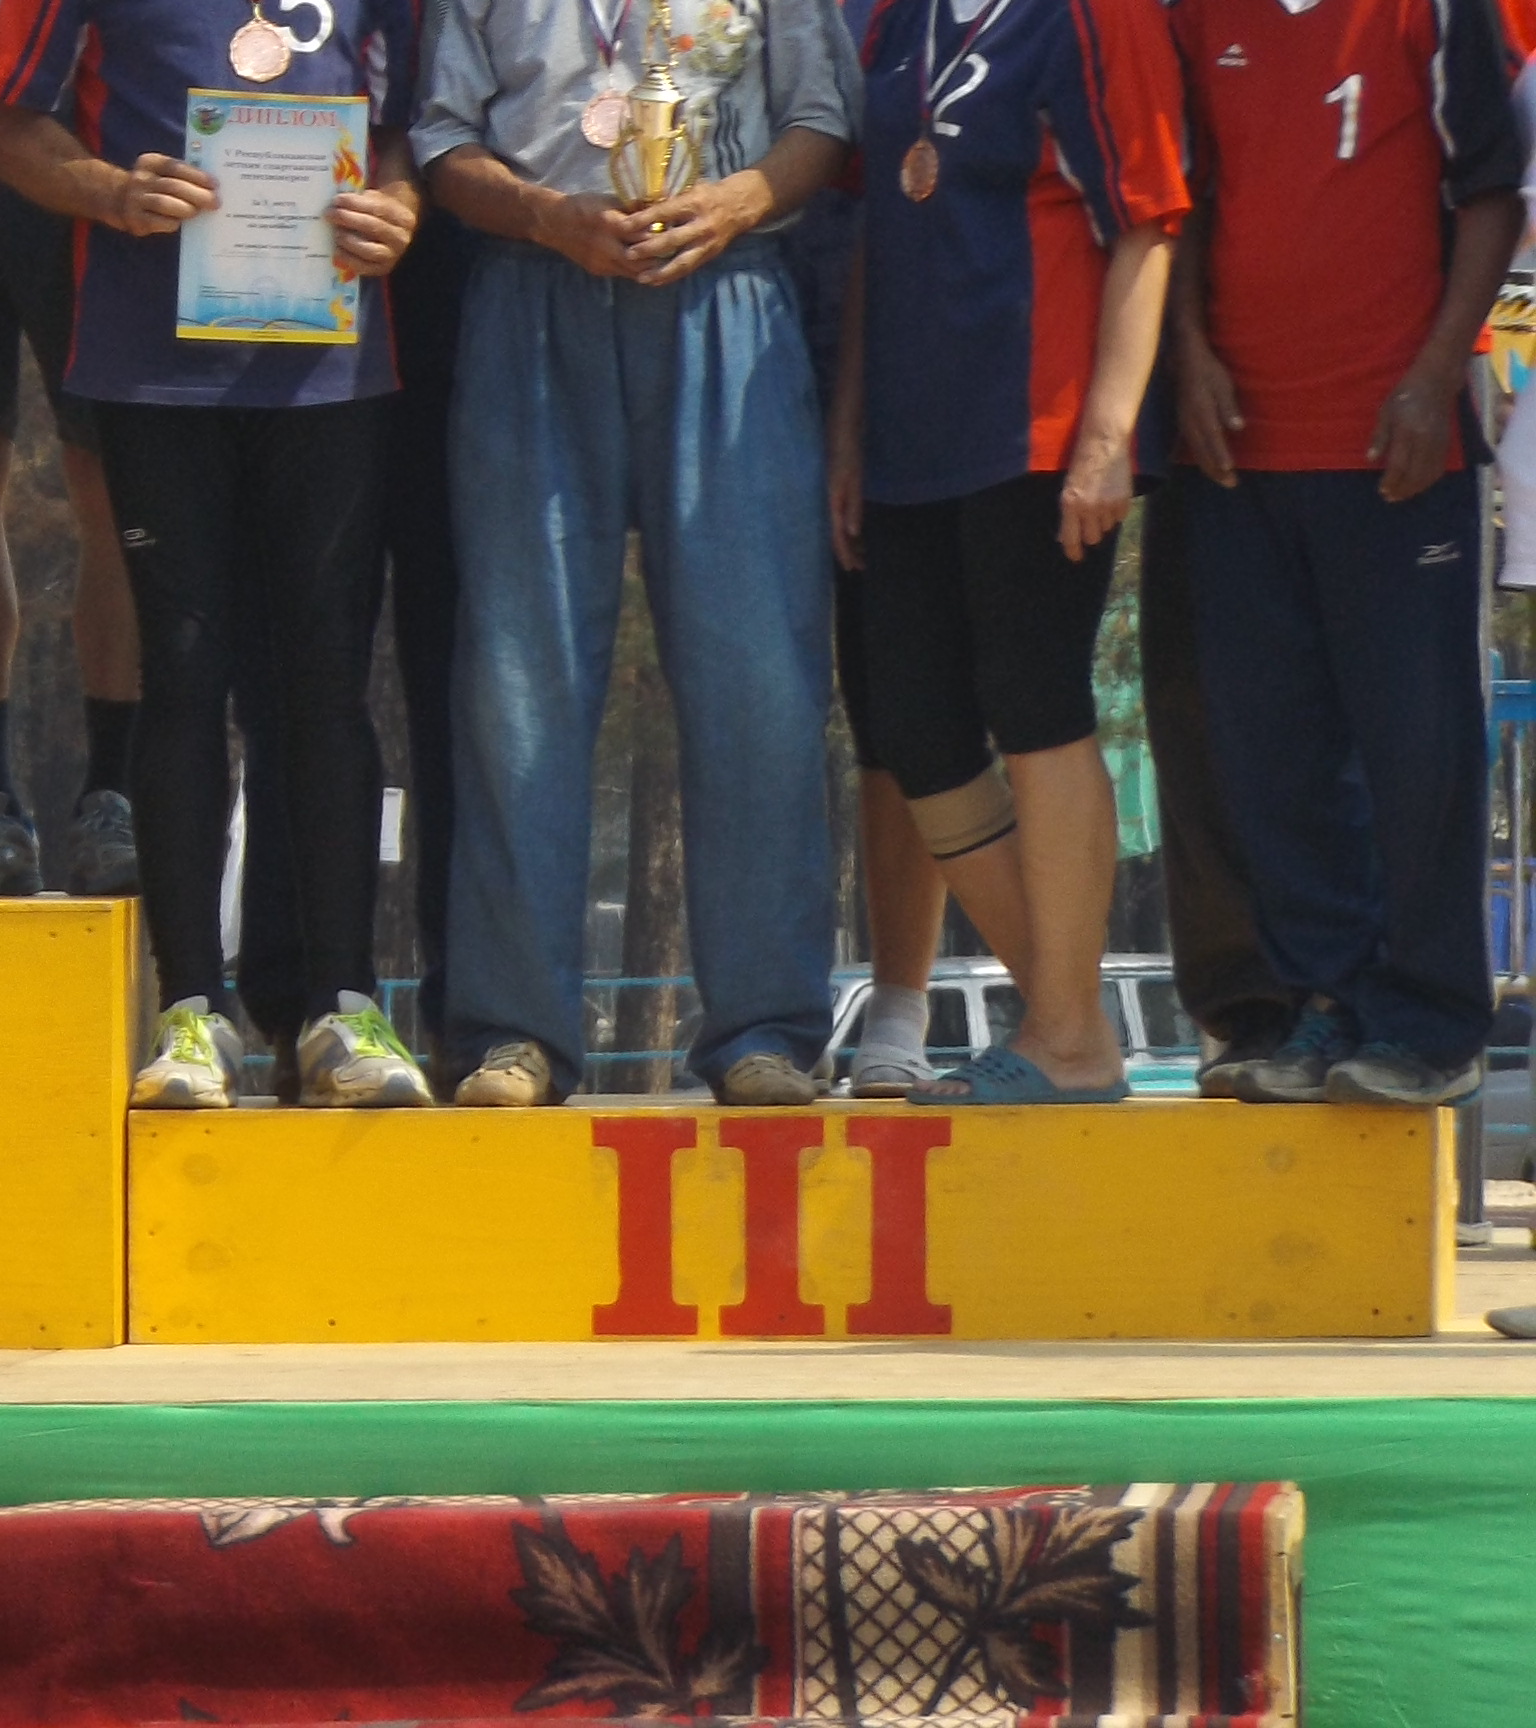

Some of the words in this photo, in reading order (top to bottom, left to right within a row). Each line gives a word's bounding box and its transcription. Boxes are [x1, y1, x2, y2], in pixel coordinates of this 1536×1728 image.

[228, 106, 337, 127] ДИПЛОМ
[933, 52, 990, 138] 2
[1324, 73, 1364, 159] 1
[592, 1116, 952, 1335] III
